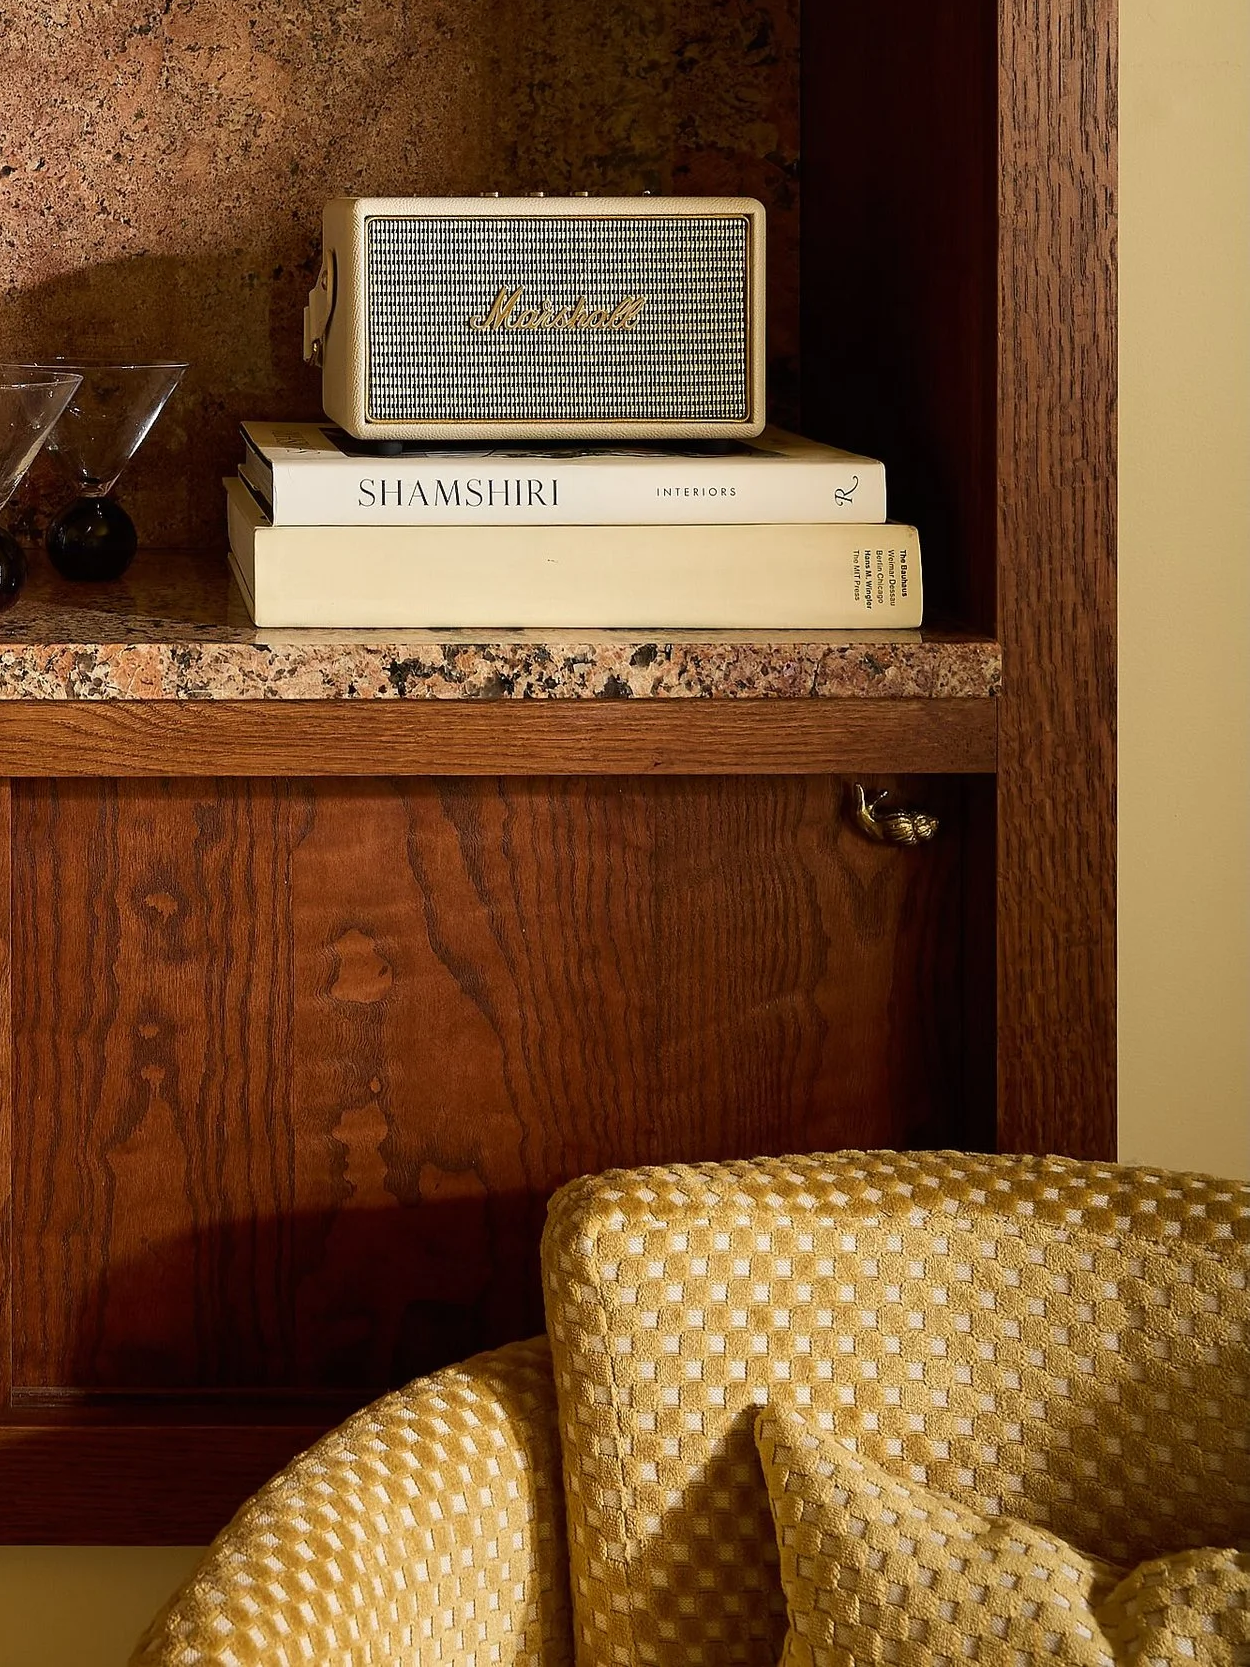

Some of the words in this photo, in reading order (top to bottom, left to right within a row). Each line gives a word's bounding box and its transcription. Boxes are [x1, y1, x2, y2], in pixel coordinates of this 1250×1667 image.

[469, 284, 646, 331] Marshall
[357, 478, 559, 507] SHAMSHIRI
[656, 487, 737, 497] INTERIORS
[899, 550, 907, 564] The
[865, 570, 872, 580] M.
[900, 565, 908, 597] Bauhaus
[865, 581, 873, 609] Wingler
[889, 579, 897, 607] Dessau
